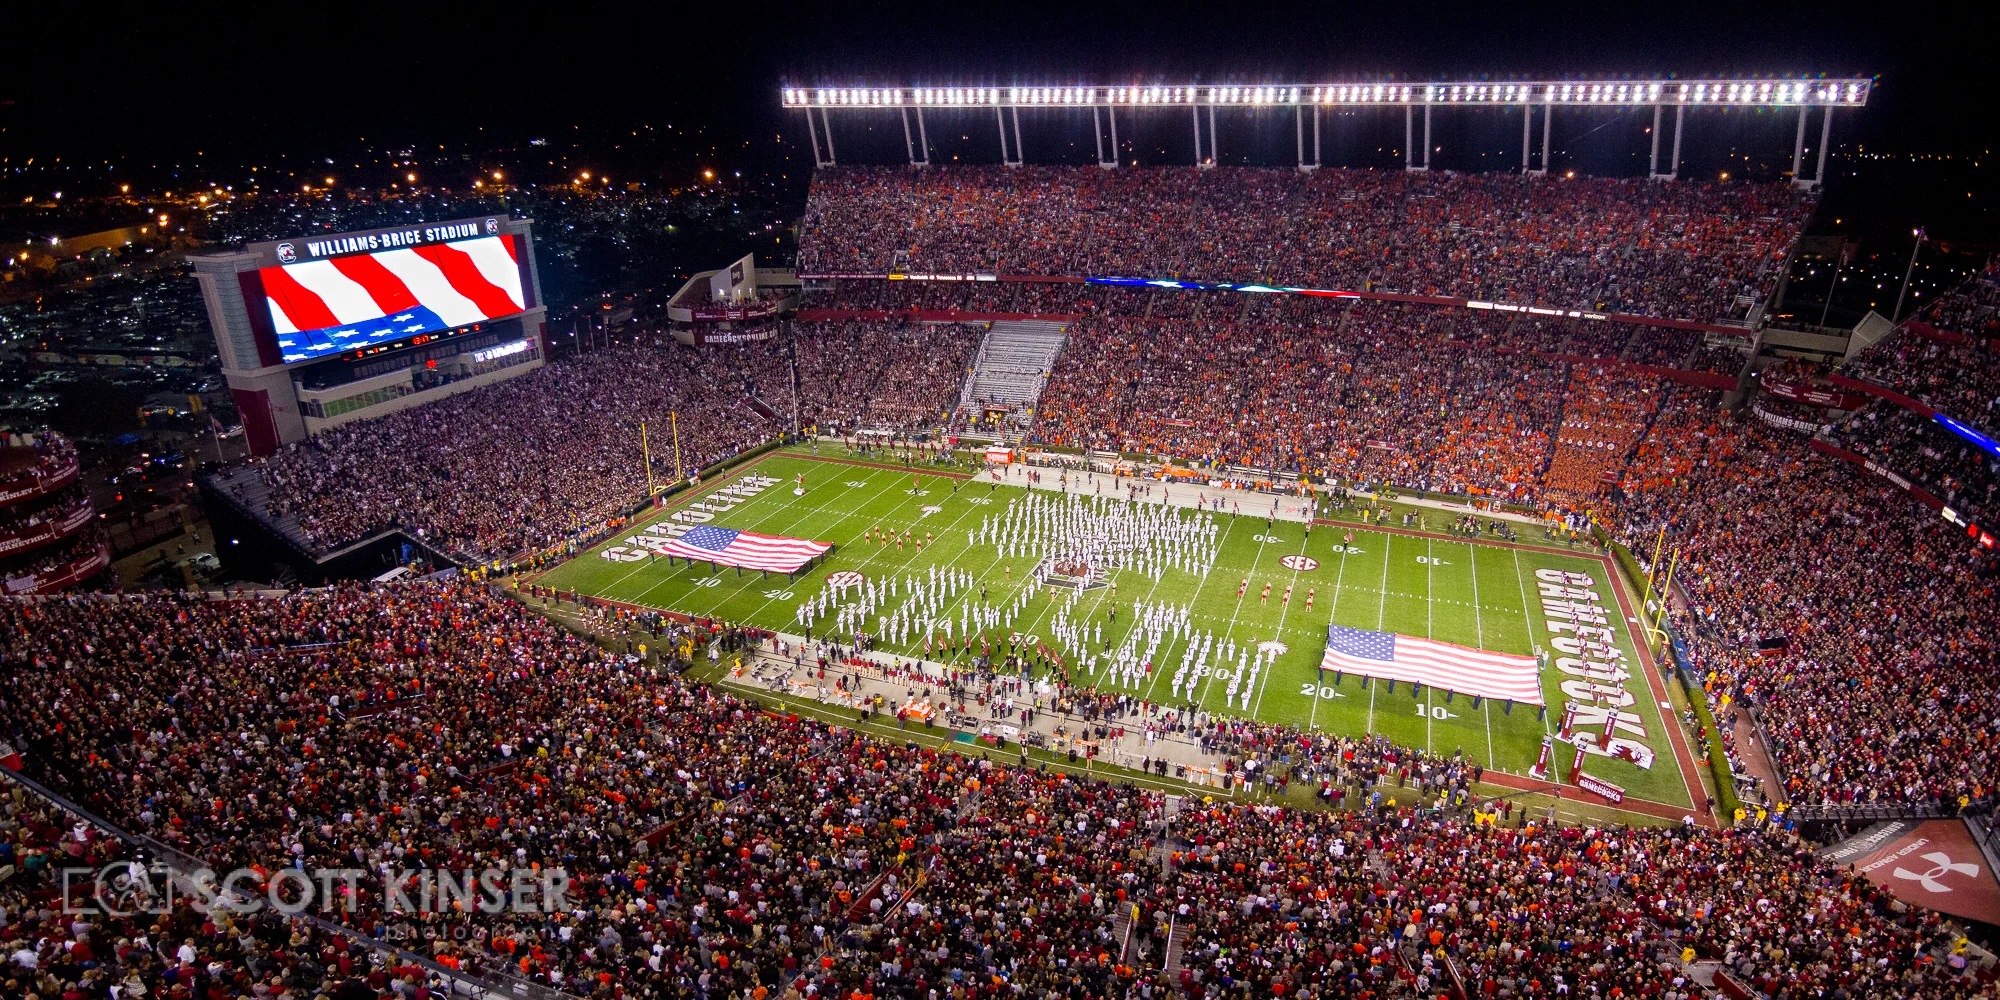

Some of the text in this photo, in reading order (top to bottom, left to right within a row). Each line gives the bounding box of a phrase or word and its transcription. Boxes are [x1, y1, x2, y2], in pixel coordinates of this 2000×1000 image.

[307, 223, 479, 257] WILLIAMS-BRICE STADIUM
[1584, 312, 1606, 320] verizon
[1764, 411, 1818, 432] WILLIAMS-BRICE
[600, 476, 783, 562] CAROLINA
[1281, 555, 1319, 571] SEC
[695, 576, 722, 588] 10
[827, 571, 864, 587] SEC
[764, 589, 795, 601] 20
[1535, 568, 1655, 764] GAMECOCKS
[1300, 683, 1337, 700] 20
[1415, 703, 1449, 720] 10
[1579, 779, 1621, 802] GAMECOCKS
[1859, 838, 1930, 872] UNDER ARMOUR
